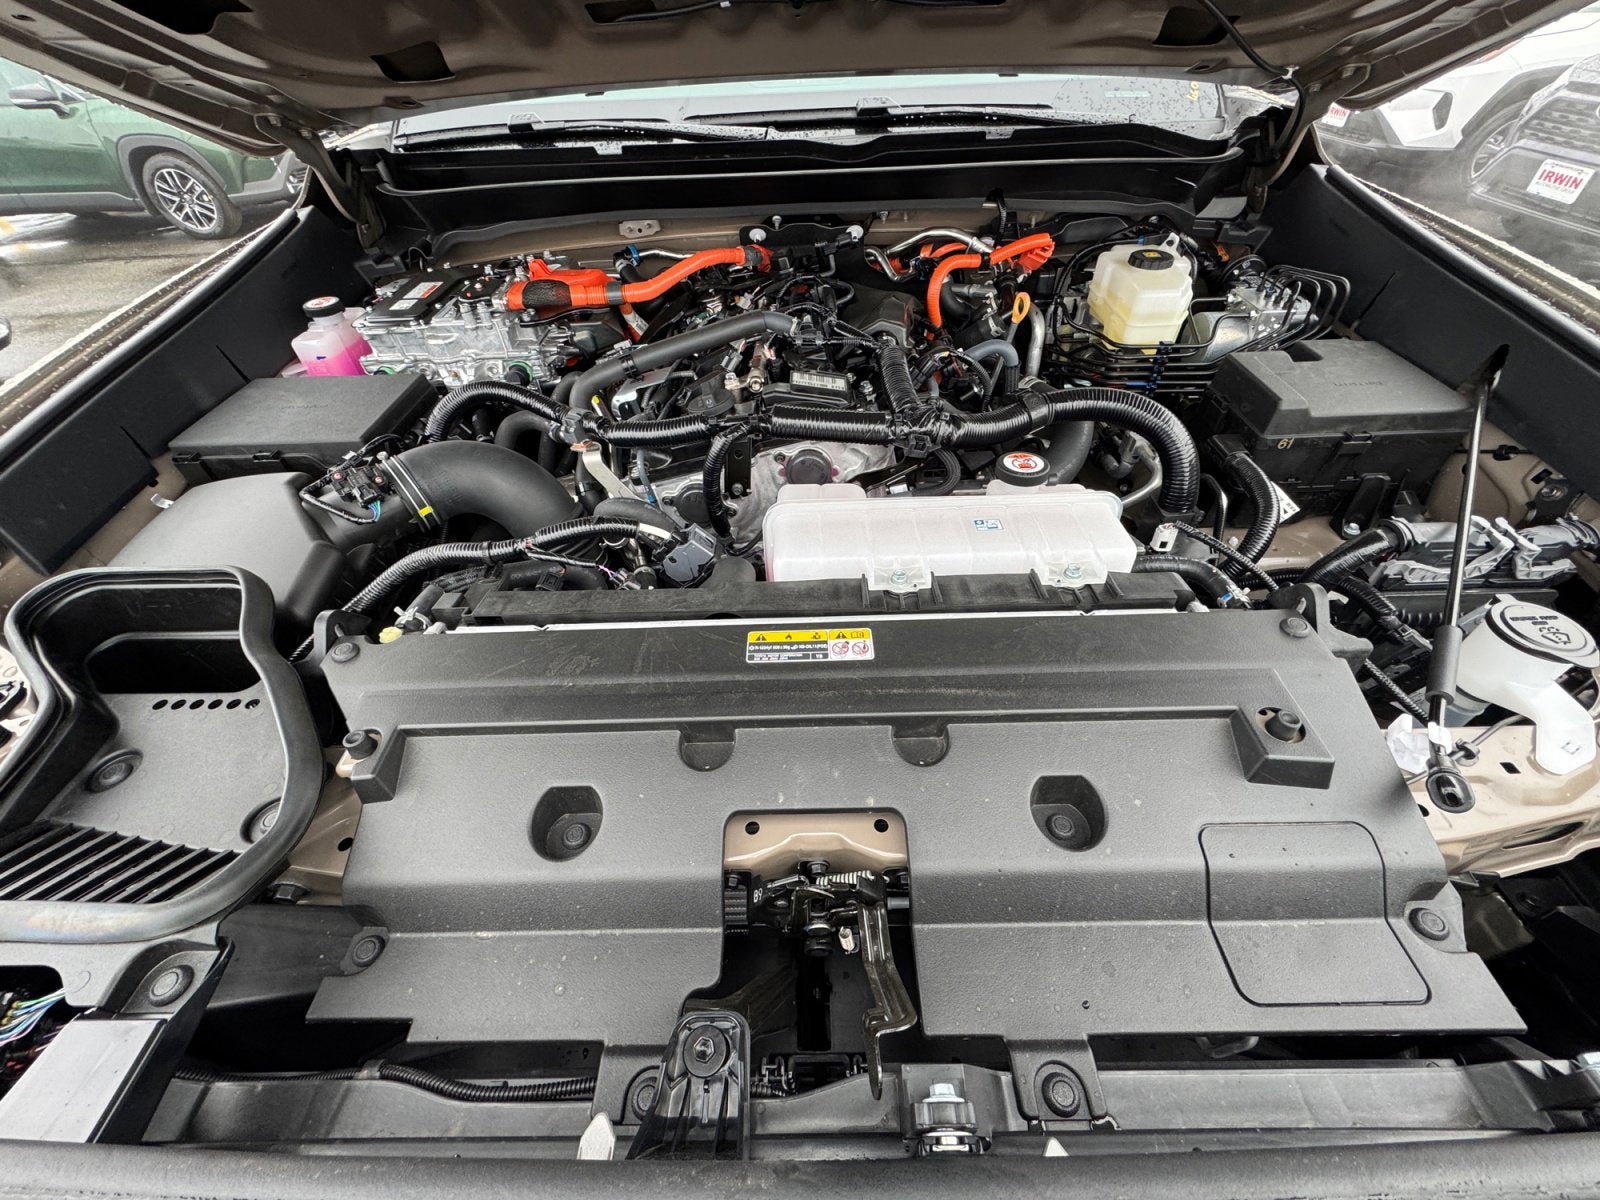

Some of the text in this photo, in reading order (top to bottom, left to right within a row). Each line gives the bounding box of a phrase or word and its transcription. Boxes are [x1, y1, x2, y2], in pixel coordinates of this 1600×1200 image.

[1329, 106, 1347, 118] RWIN
[1538, 169, 1584, 190] IRWIN
[1277, 438, 1295, 450] 61
